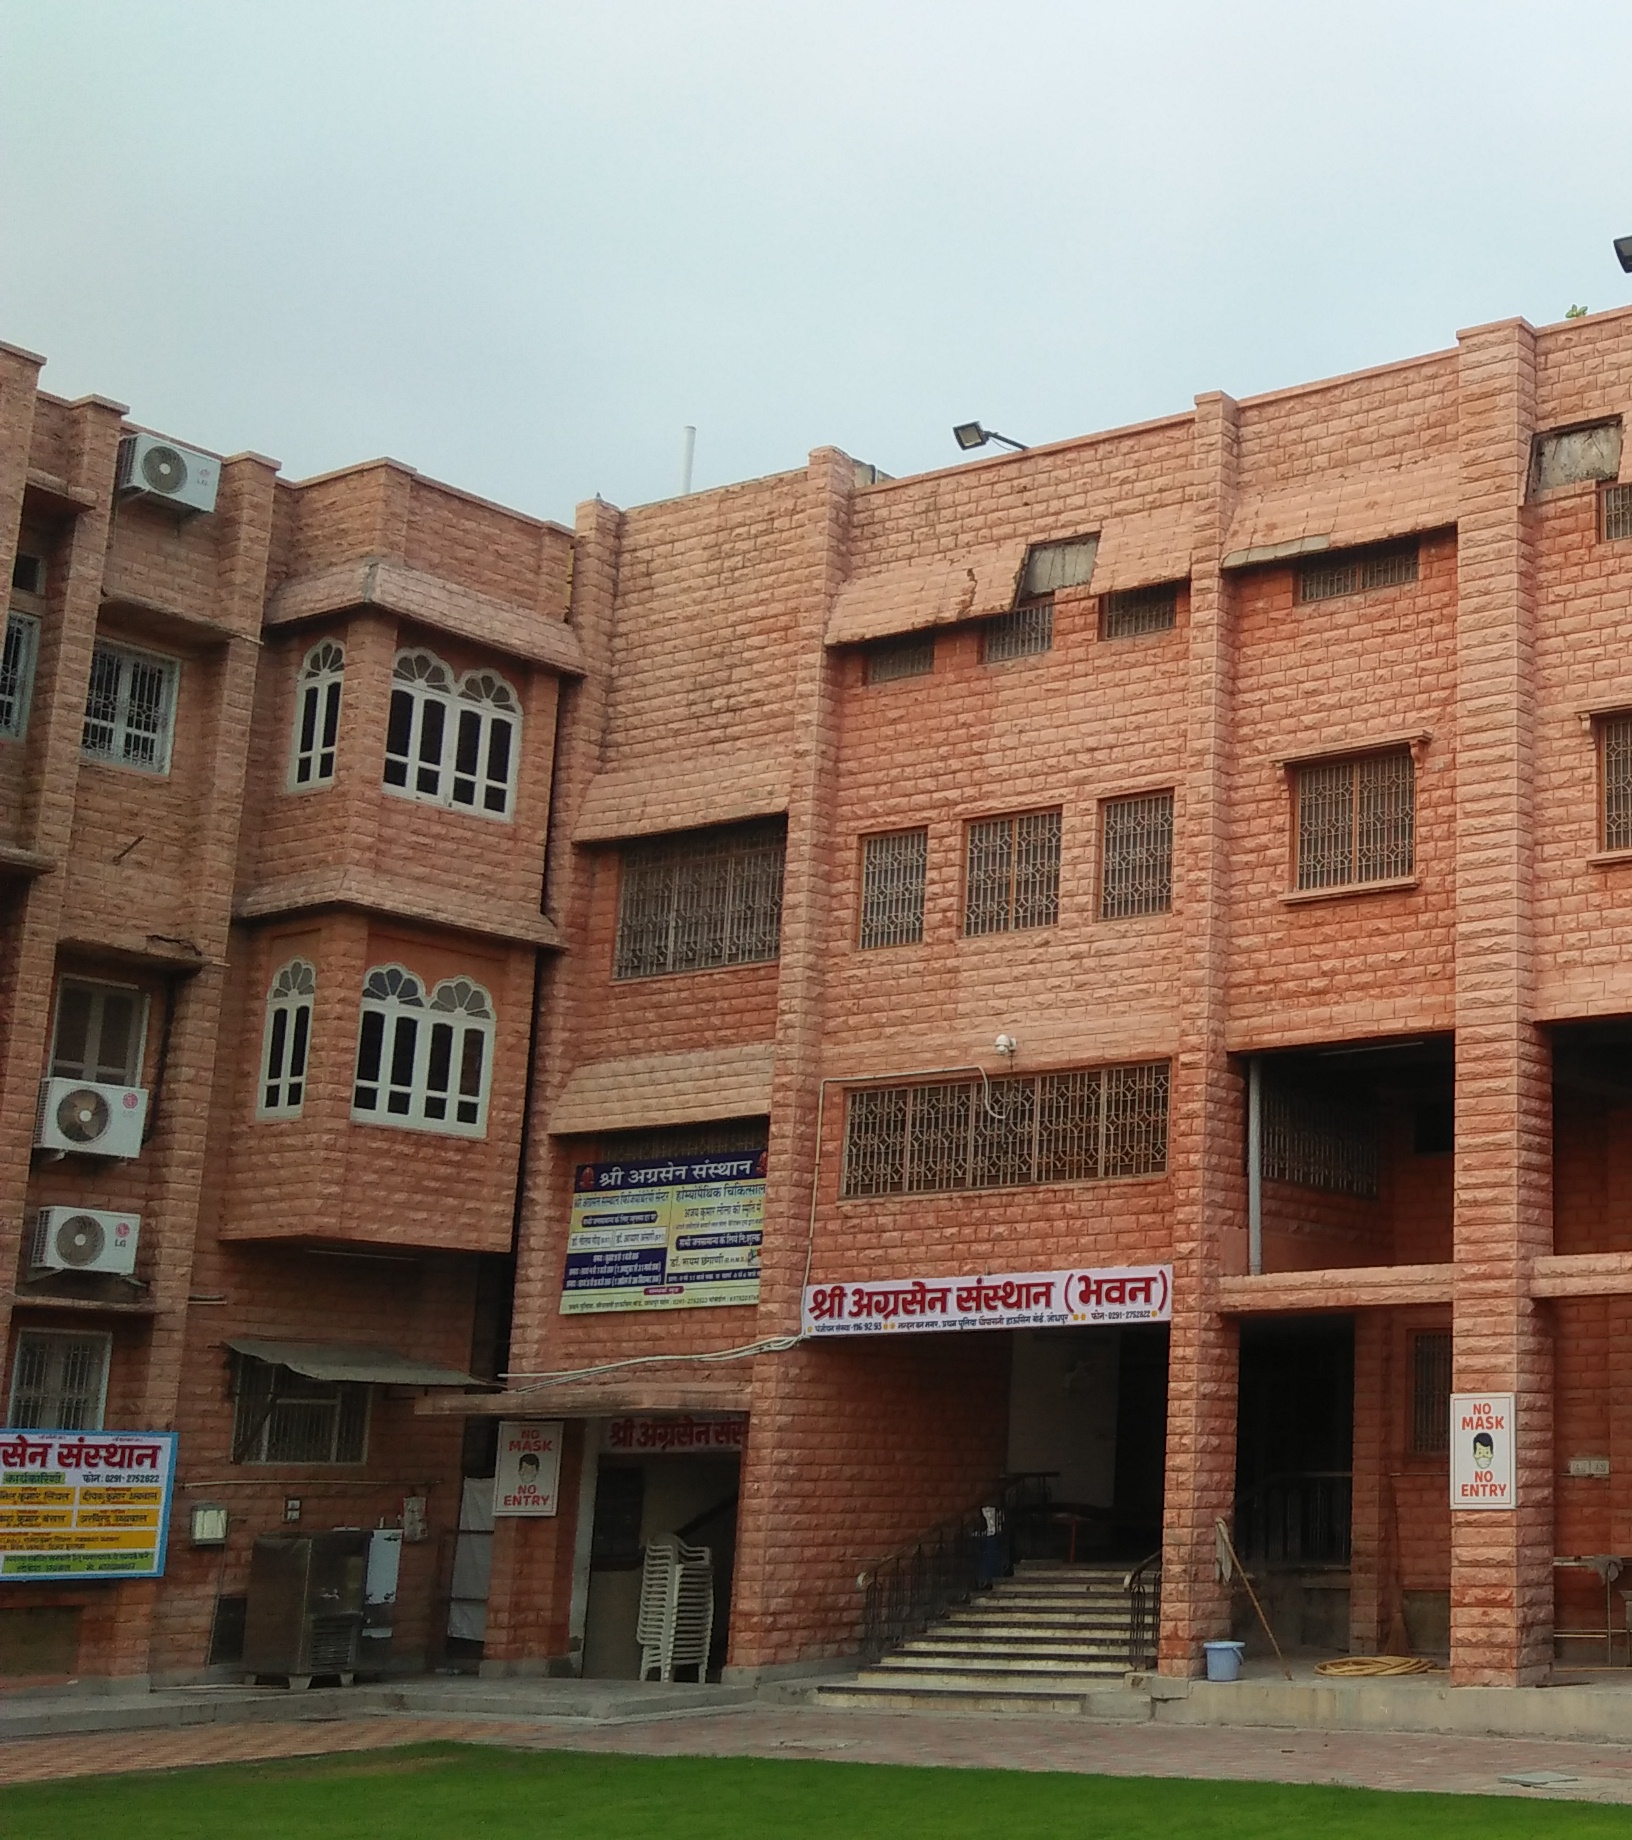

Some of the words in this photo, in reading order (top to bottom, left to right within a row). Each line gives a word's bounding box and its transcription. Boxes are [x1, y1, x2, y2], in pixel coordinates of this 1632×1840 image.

[599, 1166, 624, 1187] श्री
[627, 1161, 688, 1184] अग्रसेन
[692, 1158, 753, 1180] संस्थान
[723, 1182, 766, 1197] चिकित्साल
[115, 1239, 127, 1248] LG
[808, 1284, 847, 1321] श्री
[851, 1281, 951, 1320] अग्रसेन
[956, 1275, 1055, 1313] संस्थान
[1063, 1269, 1169, 1314] (भवन)
[1473, 1403, 1491, 1415] NO
[1461, 1416, 1505, 1431] MASK
[521, 1429, 540, 1440] NO
[608, 1417, 636, 1448] श्री
[636, 1415, 712, 1451] अग्रसेन
[0, 1434, 52, 1468] सेन
[57, 1436, 161, 1469] संस्थान
[509, 1440, 552, 1452] MASK
[1474, 1470, 1494, 1483] NO
[517, 1484, 537, 1495] NO
[1461, 1484, 1507, 1497] ENTRY
[503, 1495, 550, 1507] ENTRY
